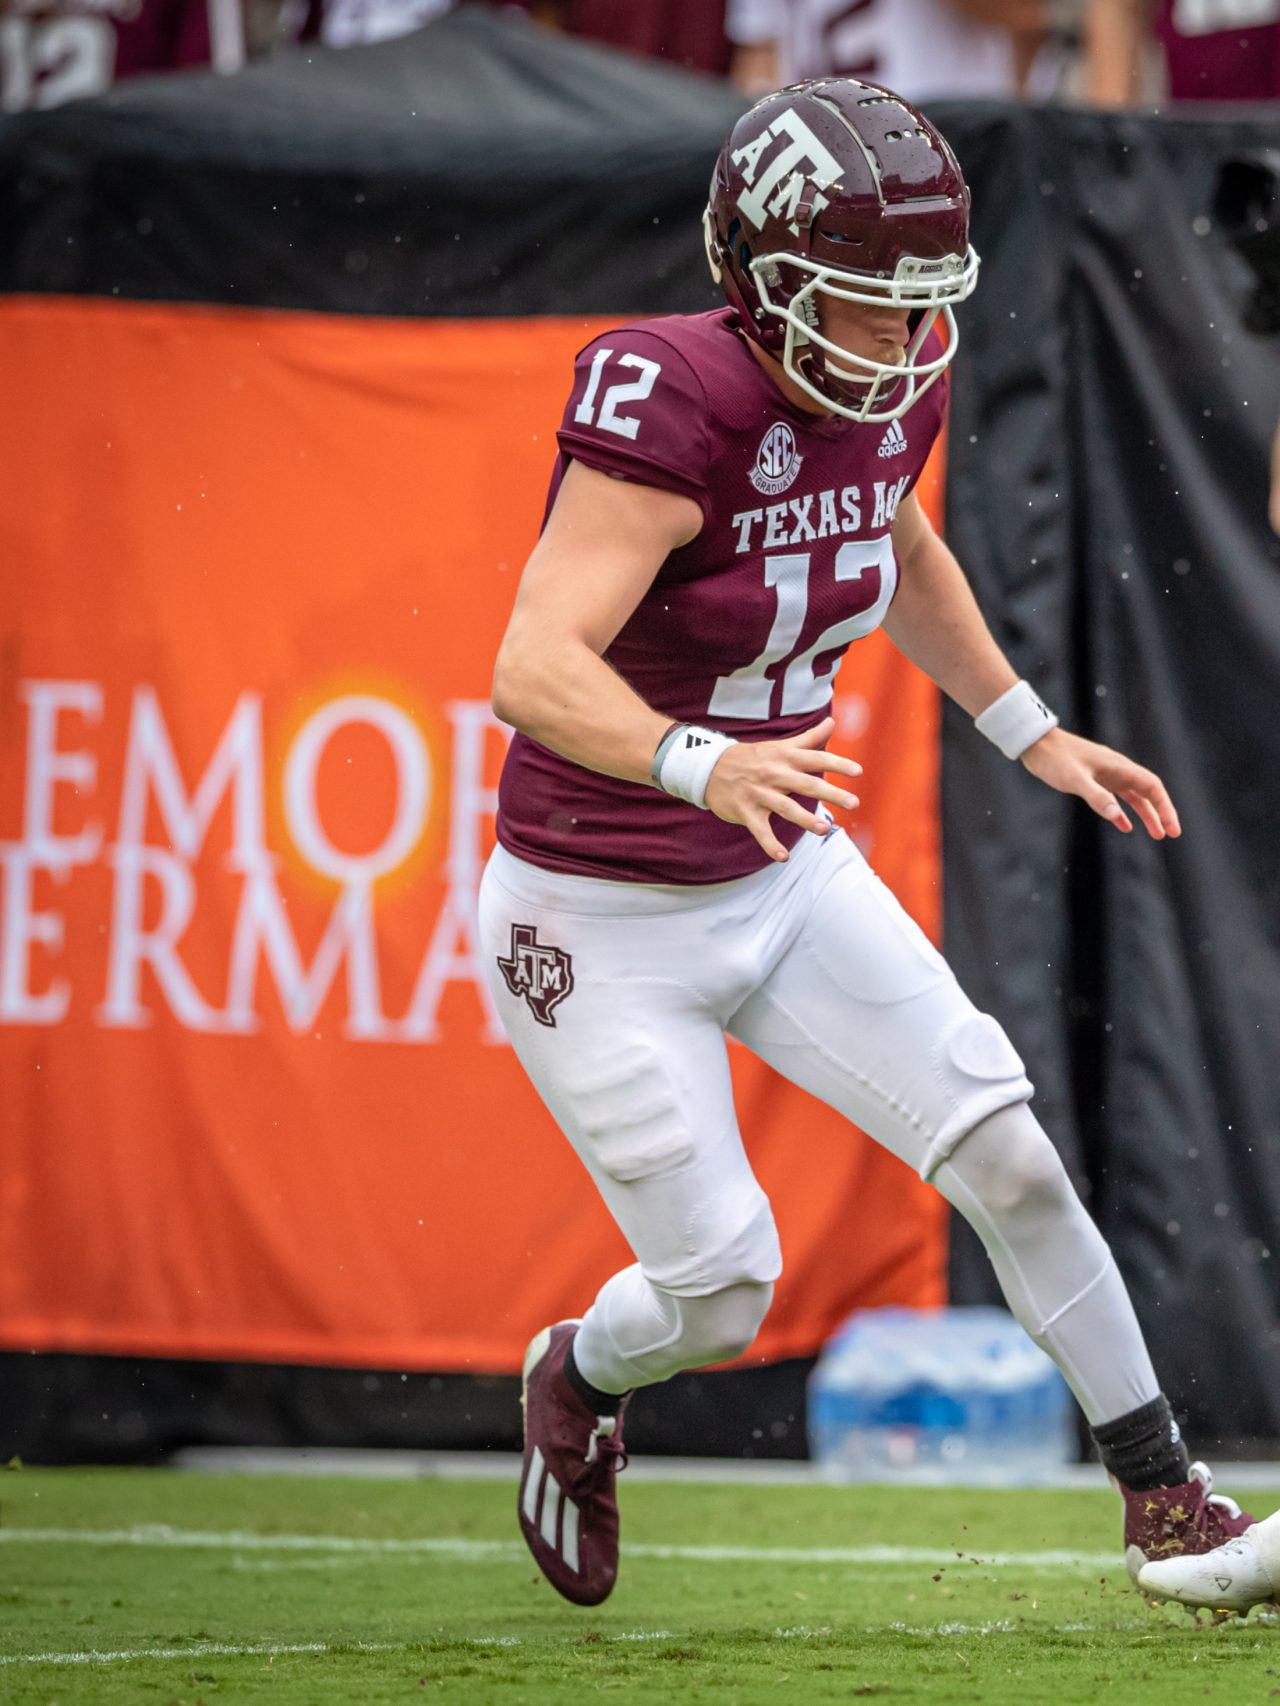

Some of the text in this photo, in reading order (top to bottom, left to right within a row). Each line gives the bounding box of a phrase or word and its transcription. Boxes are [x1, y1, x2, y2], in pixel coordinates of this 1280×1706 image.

[574, 348, 661, 440] 12
[755, 463, 798, 493] GRADUATE
[761, 426, 793, 477] SEC
[877, 440, 908, 459] adidas
[732, 485, 861, 554] TEXAS
[706, 533, 897, 721] 12
